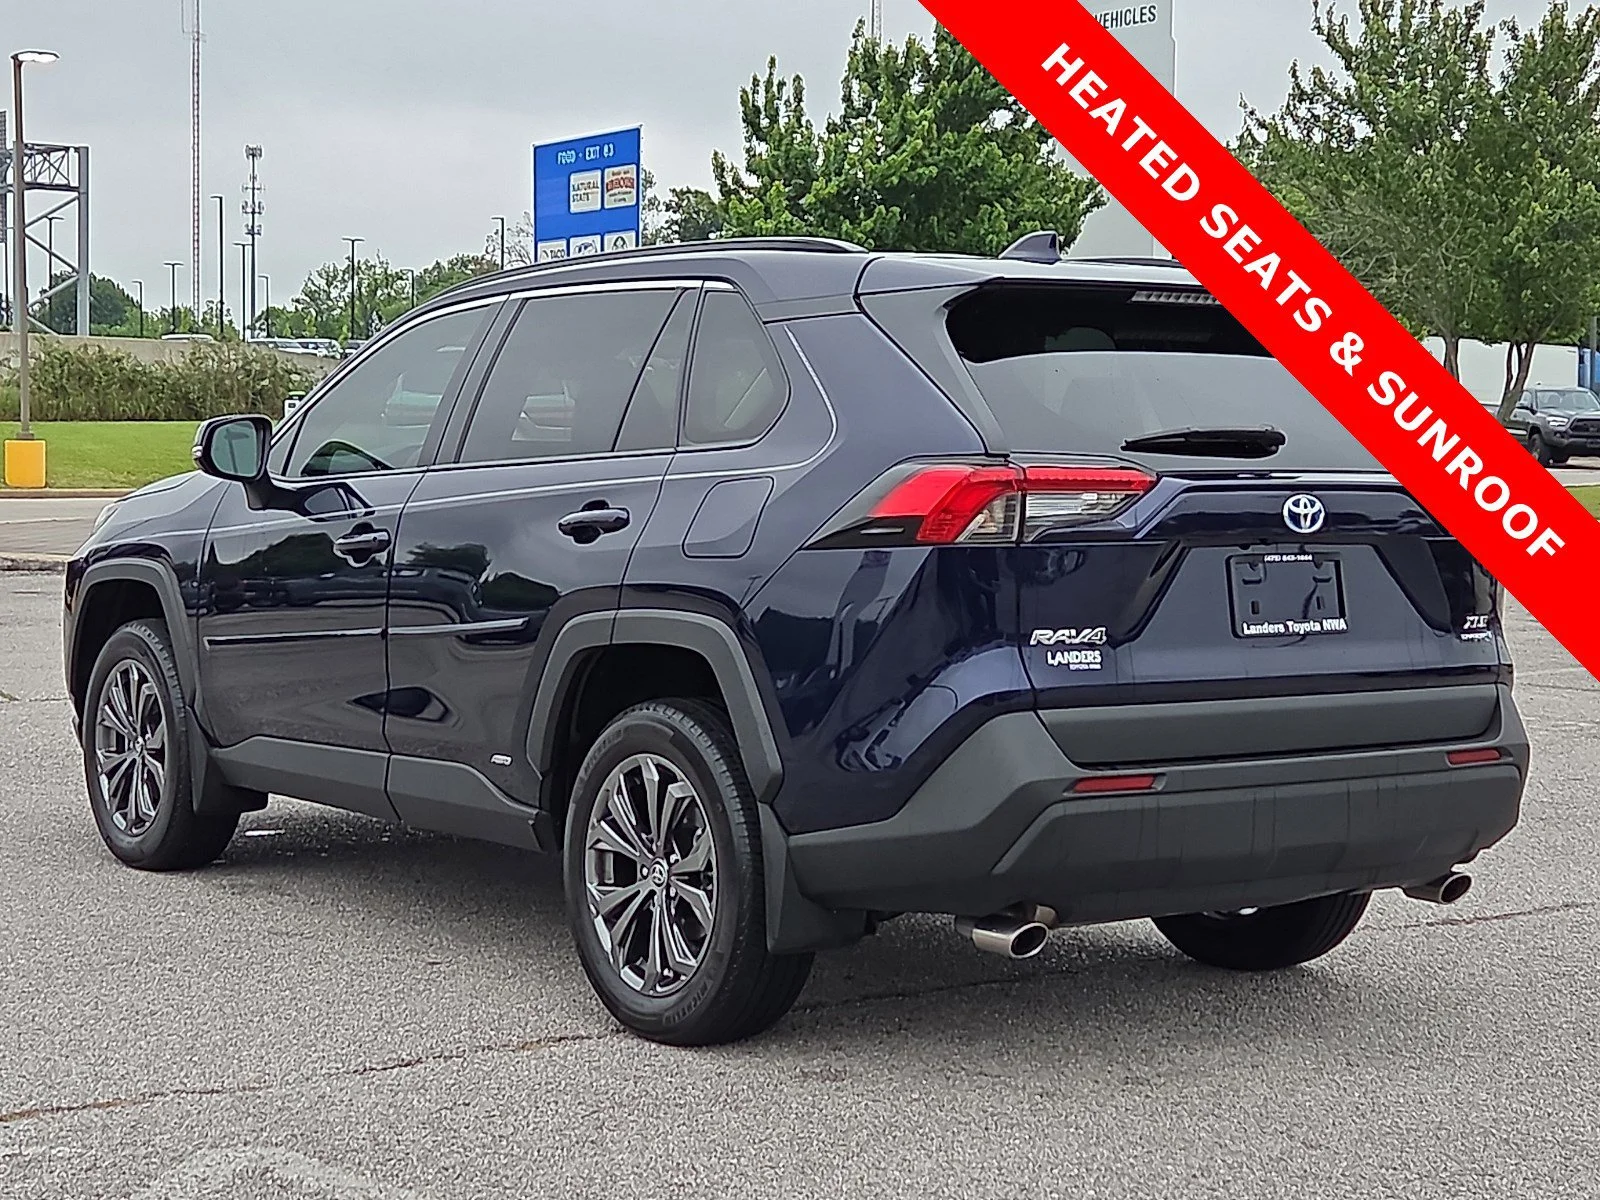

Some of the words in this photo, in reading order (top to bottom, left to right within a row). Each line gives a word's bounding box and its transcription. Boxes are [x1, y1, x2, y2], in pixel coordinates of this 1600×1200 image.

[1094, 5, 1157, 29] VEHICLES
[585, 146, 600, 160] EXIT
[550, 249, 566, 259] TACO
[1242, 621, 1286, 635] Landers
[1286, 620, 1321, 634] Toyota
[1322, 618, 1348, 631] NWA
[1029, 627, 1107, 646] RAV4
[1047, 651, 1102, 666] LANDERS
